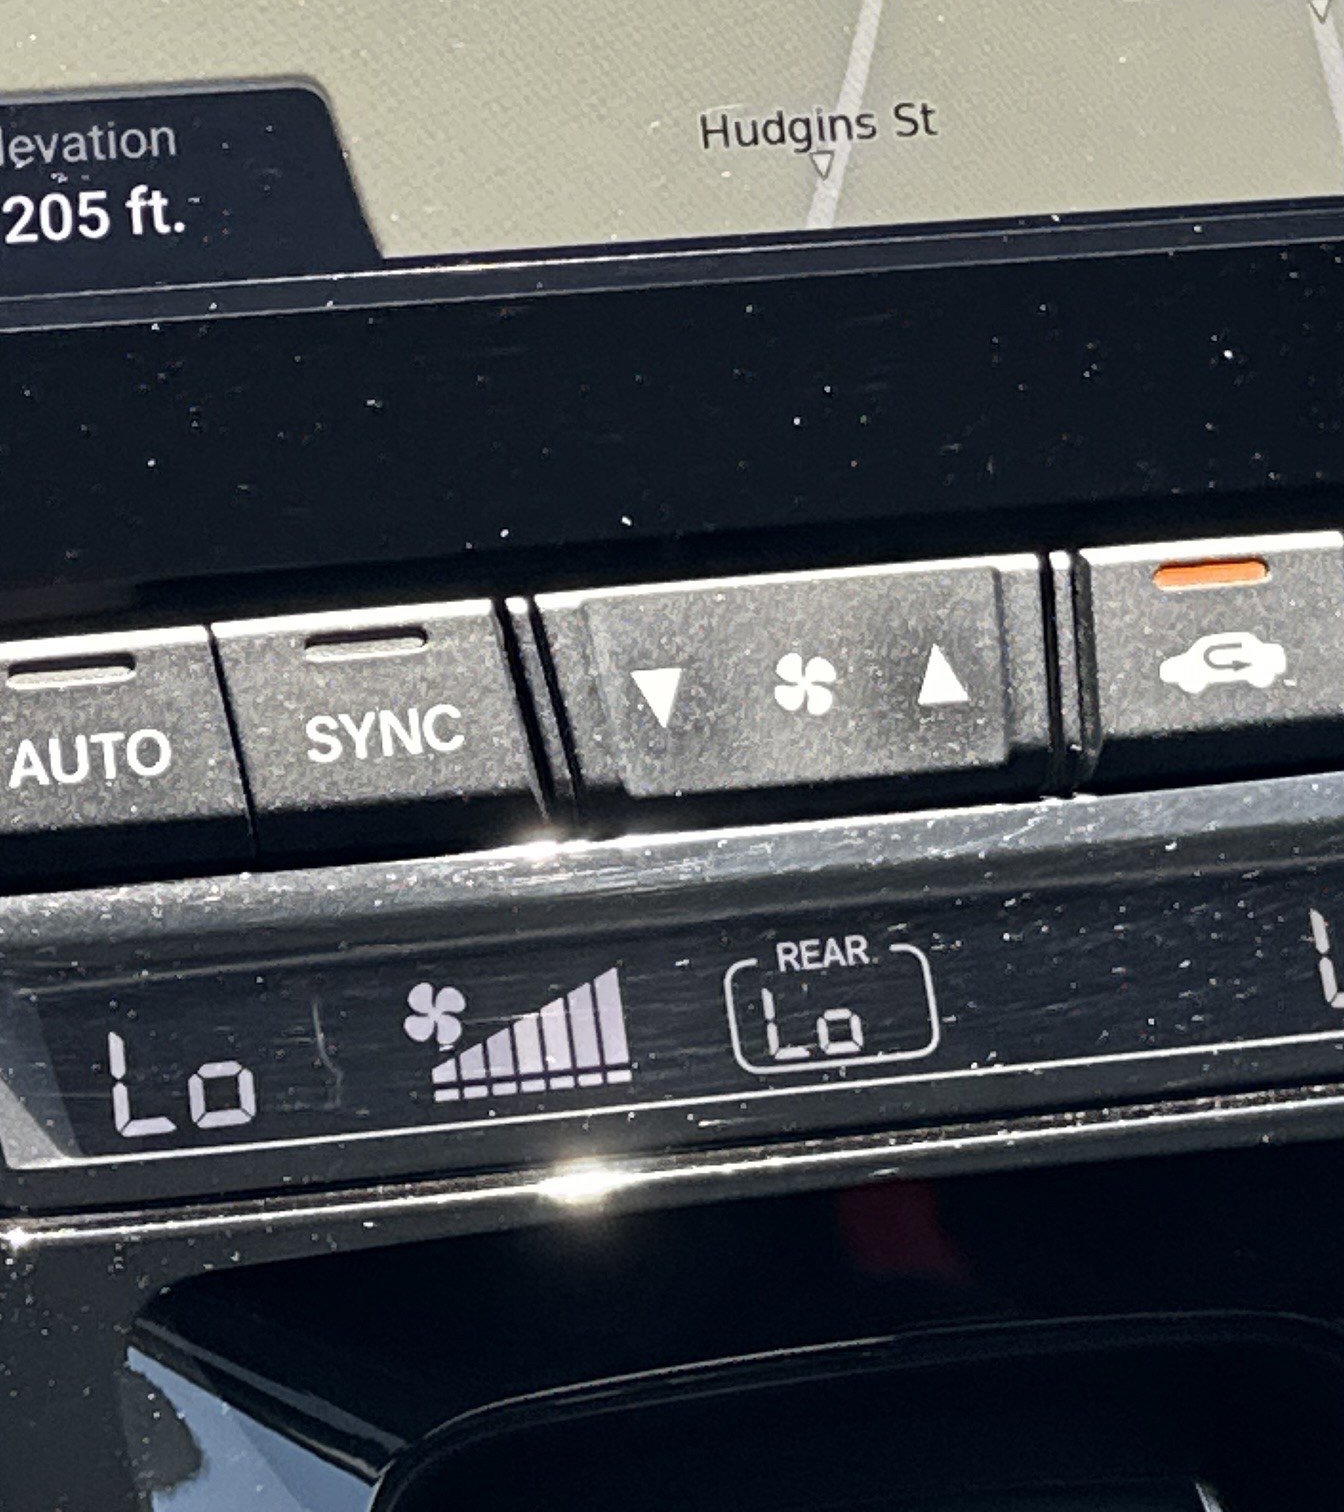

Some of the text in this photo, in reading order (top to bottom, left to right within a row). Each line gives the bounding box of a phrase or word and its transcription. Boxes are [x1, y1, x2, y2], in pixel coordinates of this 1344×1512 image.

[701, 103, 938, 153] Hudgins St
[124, 185, 186, 236] ft.
[8, 729, 172, 788] AUTO
[304, 704, 466, 764] SYNC
[776, 934, 870, 973] REAR
[760, 987, 864, 1061] Lo
[107, 1031, 256, 1138] Lo
